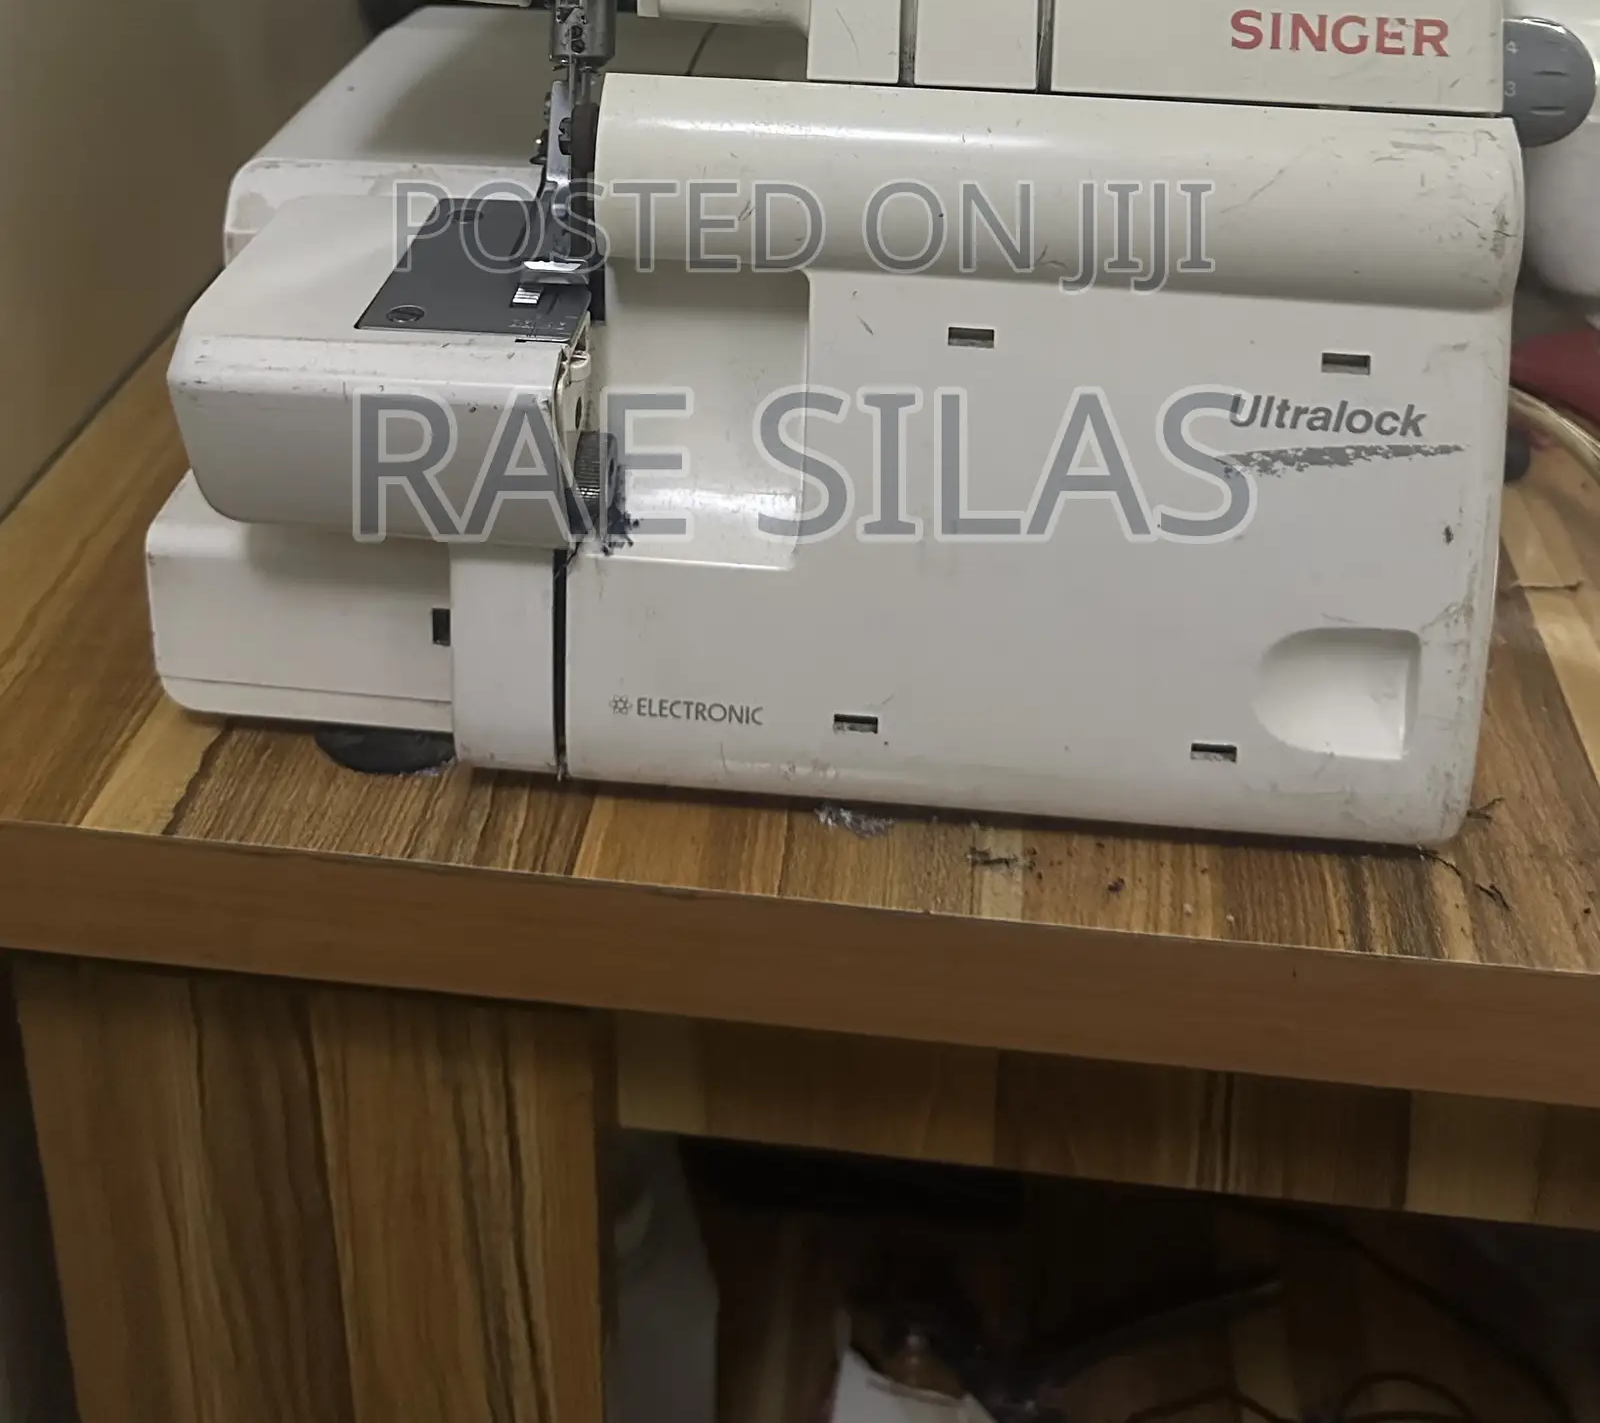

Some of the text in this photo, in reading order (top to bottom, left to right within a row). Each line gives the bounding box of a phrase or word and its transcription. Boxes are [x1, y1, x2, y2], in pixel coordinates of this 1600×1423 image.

[1230, 9, 1449, 57] SINGER
[1504, 80, 1516, 97] 3
[1229, 393, 1427, 437] Ultralock
[636, 697, 764, 726] ELECTRONIC
